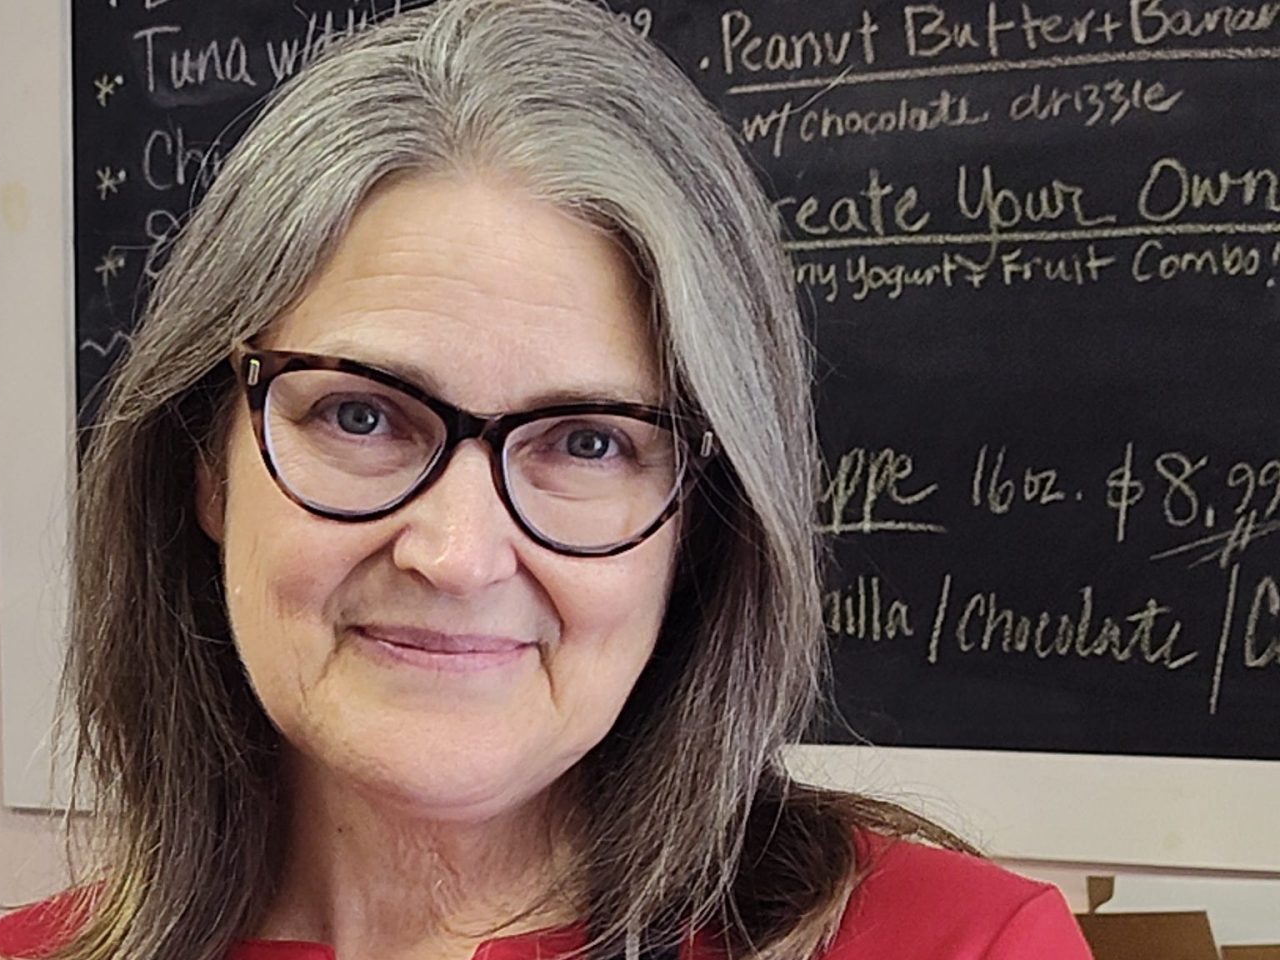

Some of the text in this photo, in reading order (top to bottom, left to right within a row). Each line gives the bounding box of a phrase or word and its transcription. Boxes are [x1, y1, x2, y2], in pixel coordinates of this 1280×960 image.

[133, 26, 257, 92] Tuna
[721, 10, 879, 74] Peanut
[1010, 79, 1185, 127] drizzle
[771, 157, 1280, 268] reate Your Own
[1001, 244, 1116, 286] Fruit
[821, 447, 939, 534] ppe
